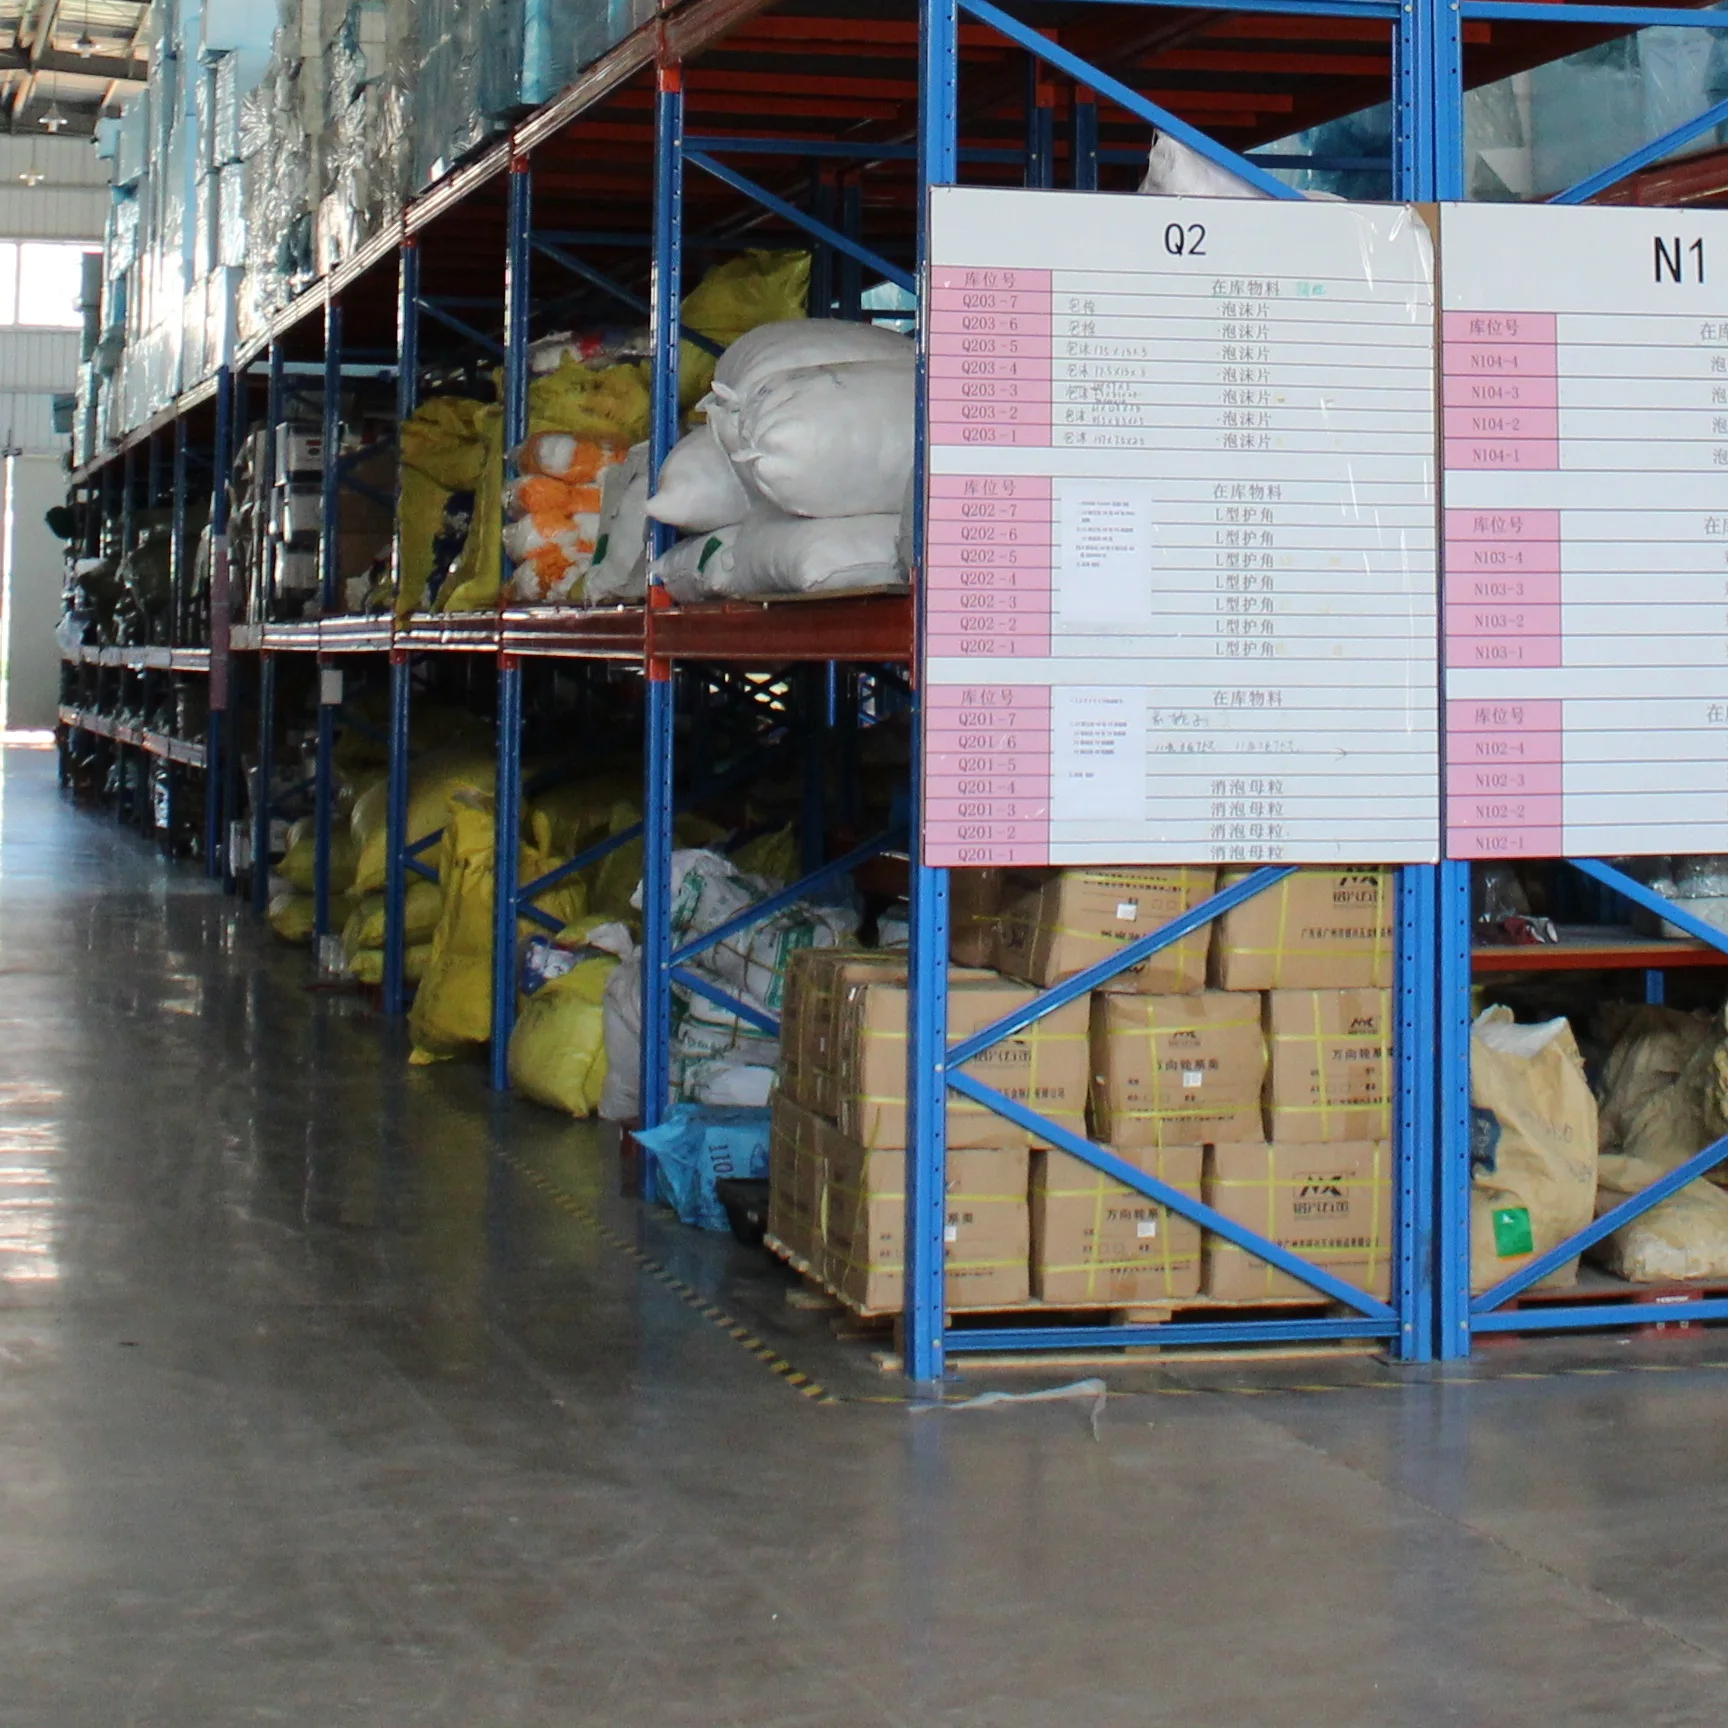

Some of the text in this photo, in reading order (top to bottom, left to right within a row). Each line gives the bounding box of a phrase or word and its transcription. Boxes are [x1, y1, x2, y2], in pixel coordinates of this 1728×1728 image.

[1165, 223, 1206, 256] Q2
[1655, 237, 1703, 283] N1
[964, 272, 1016, 287] 库位号
[1211, 280, 1280, 296] 在库物料
[963, 294, 1018, 308] Q203-7
[1221, 303, 1269, 316] 泡沫片
[962, 316, 1018, 330] Q203-6
[1470, 318, 1518, 336] 库位号
[1221, 324, 1269, 339] 泡沫片
[962, 339, 1018, 353] Q203-5
[1223, 345, 1269, 360] 泡沫片
[962, 361, 1017, 375] Q203-4
[1471, 355, 1518, 368] N104-4
[1223, 367, 1270, 382] 泡沫片
[962, 383, 1018, 397] Q203-3
[1223, 389, 1270, 404] 泡沫片
[1472, 386, 1519, 399] N104-3
[962, 405, 1018, 420] Q203-2
[1222, 412, 1271, 426] 泡沫片
[1473, 418, 1520, 431] N104-2
[962, 427, 1016, 442] Q203-1
[1224, 433, 1271, 448] 泡沫片
[1473, 449, 1519, 462] N104-1
[964, 480, 1015, 496] 库位号
[1214, 484, 1281, 500] 在库物料
[961, 503, 1017, 517] Q202-7
[1216, 507, 1274, 522] L型护角
[1474, 516, 1523, 534] 库位号
[961, 527, 1017, 541] Q202-6
[1216, 531, 1274, 544] L型护角
[961, 549, 1017, 564] Q202-5
[1216, 554, 1274, 566] L型护角
[1474, 551, 1523, 564] N103-4
[960, 572, 1016, 586] Q202-4
[1216, 576, 1274, 588] L型护角
[1475, 582, 1524, 596] N103-3
[960, 594, 1017, 608] Q202-3
[1216, 598, 1274, 610] L型护角
[960, 617, 1016, 631] Q202-2
[1216, 620, 1275, 632] L型护角
[1475, 614, 1524, 628] N103-2
[960, 639, 1014, 654] Q202-1
[1216, 642, 1274, 655] L型护角
[1476, 646, 1522, 659] N103-1
[961, 690, 1013, 704] 库位号
[1213, 689, 1283, 706] 在库物料
[959, 713, 1016, 727] Q201-7
[1475, 707, 1523, 725] 库位号
[958, 735, 1016, 749] Q201-6
[1476, 742, 1524, 755] N102-4
[958, 758, 1016, 772] Q201-5
[1476, 774, 1525, 787] N102-3
[958, 781, 1015, 795] Q201-4
[958, 803, 1016, 817] Q201-3
[1476, 805, 1525, 818] N102-2
[958, 826, 1015, 840] Q201-2
[1476, 836, 1523, 850] N102-1
[958, 848, 1013, 862] Q201-1
